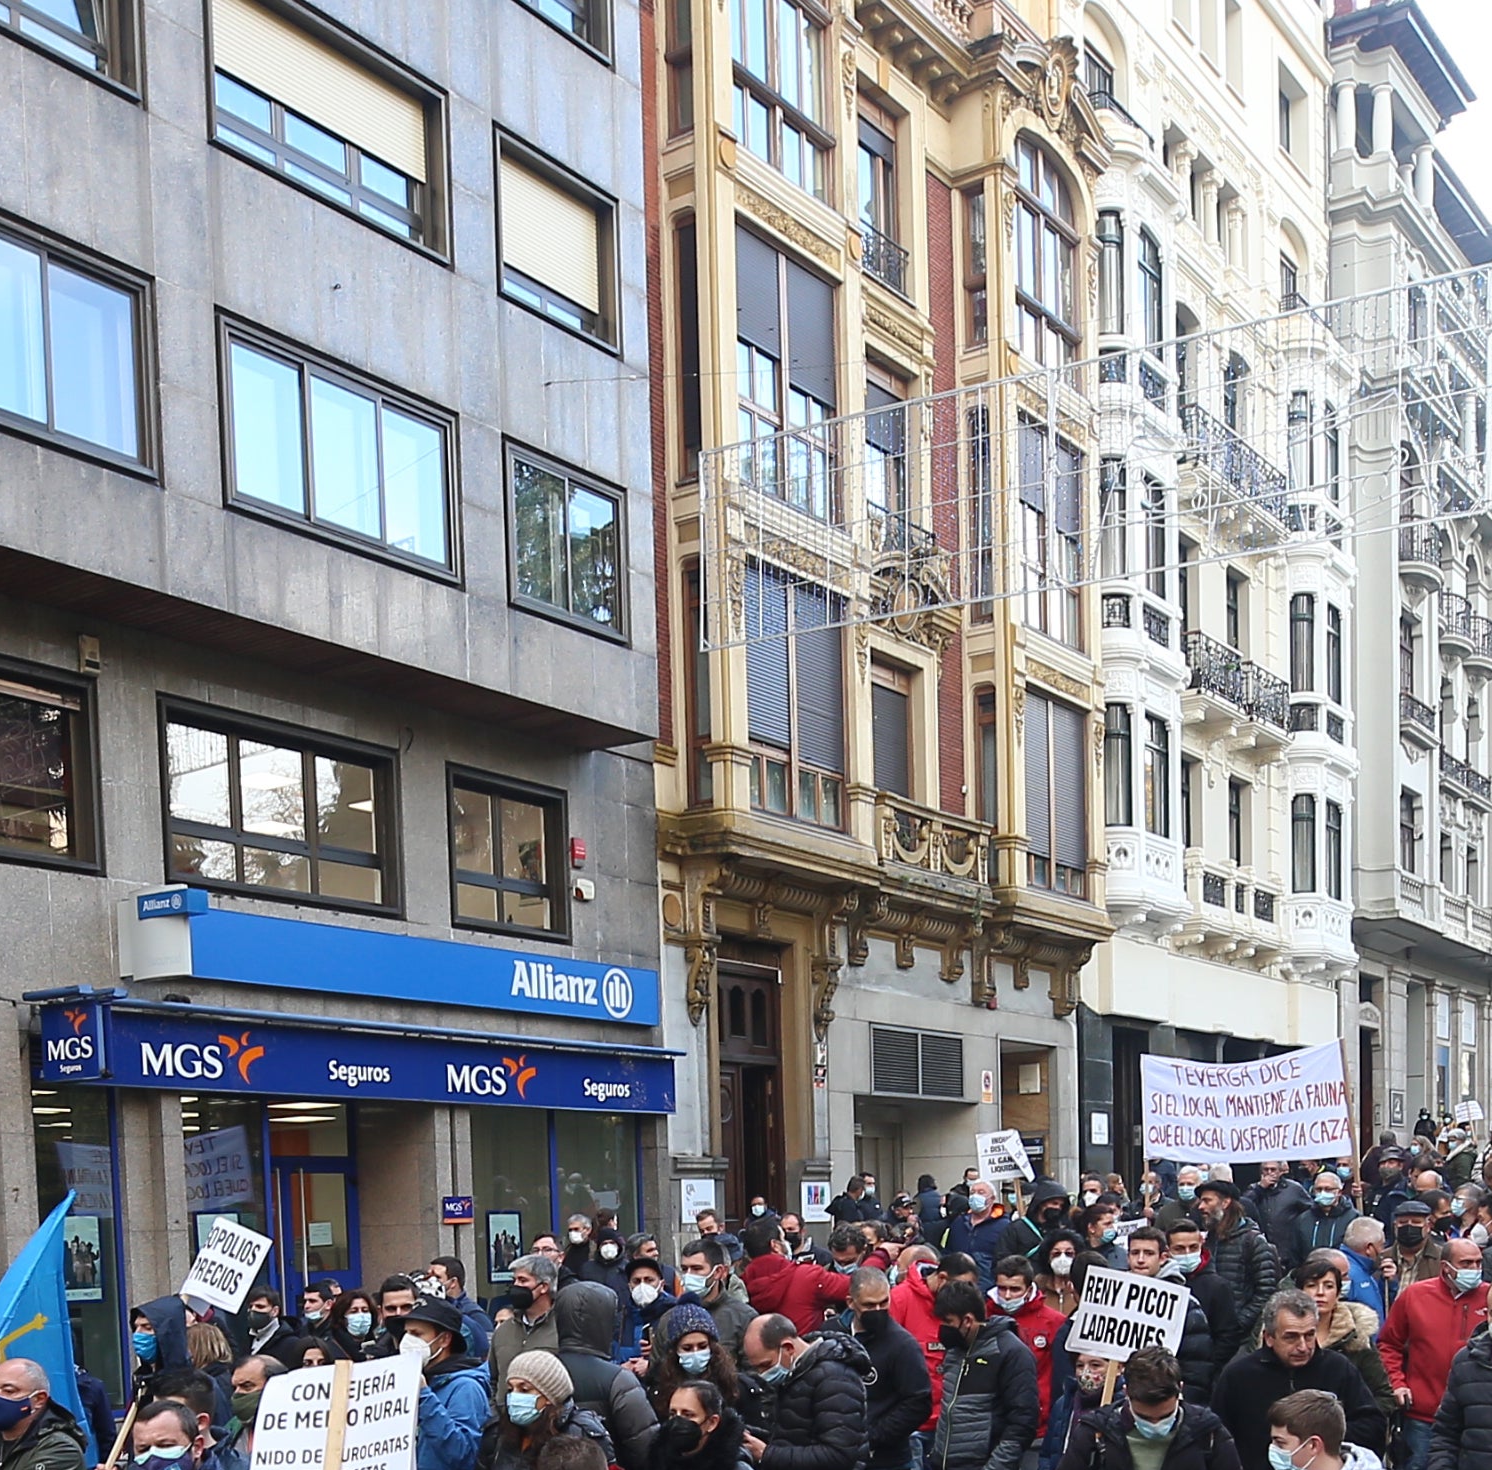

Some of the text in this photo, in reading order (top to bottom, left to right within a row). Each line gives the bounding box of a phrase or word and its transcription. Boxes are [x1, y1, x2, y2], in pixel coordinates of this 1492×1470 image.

[143, 897, 170, 912] Allianz
[510, 959, 598, 1006] Allianz
[47, 1035, 94, 1061] MGS
[140, 1042, 224, 1079] MGS
[328, 1059, 390, 1087] Seguros
[446, 1064, 507, 1096] MGS
[1171, 1057, 1301, 1087] TEVERGA DICE
[583, 1078, 630, 1102] Seguros
[1151, 1081, 1348, 1118] SI EL LOCAL MANTIENE LA FAUNA
[1148, 1124, 1172, 1147] QUE
[1189, 1126, 1226, 1150] LOCAL
[1230, 1124, 1290, 1152] DISFRUTE
[1292, 1122, 1307, 1147] LA
[1309, 1117, 1351, 1144] CAZA
[1084, 1275, 1179, 1321] RENY PICOT
[1079, 1312, 1166, 1350] LADRONES
[292, 1369, 396, 1402] CONEJERÍA
[263, 1396, 410, 1431] DE MEO RURAL
[256, 1434, 410, 1465] NIDO DE UROCRATAS
